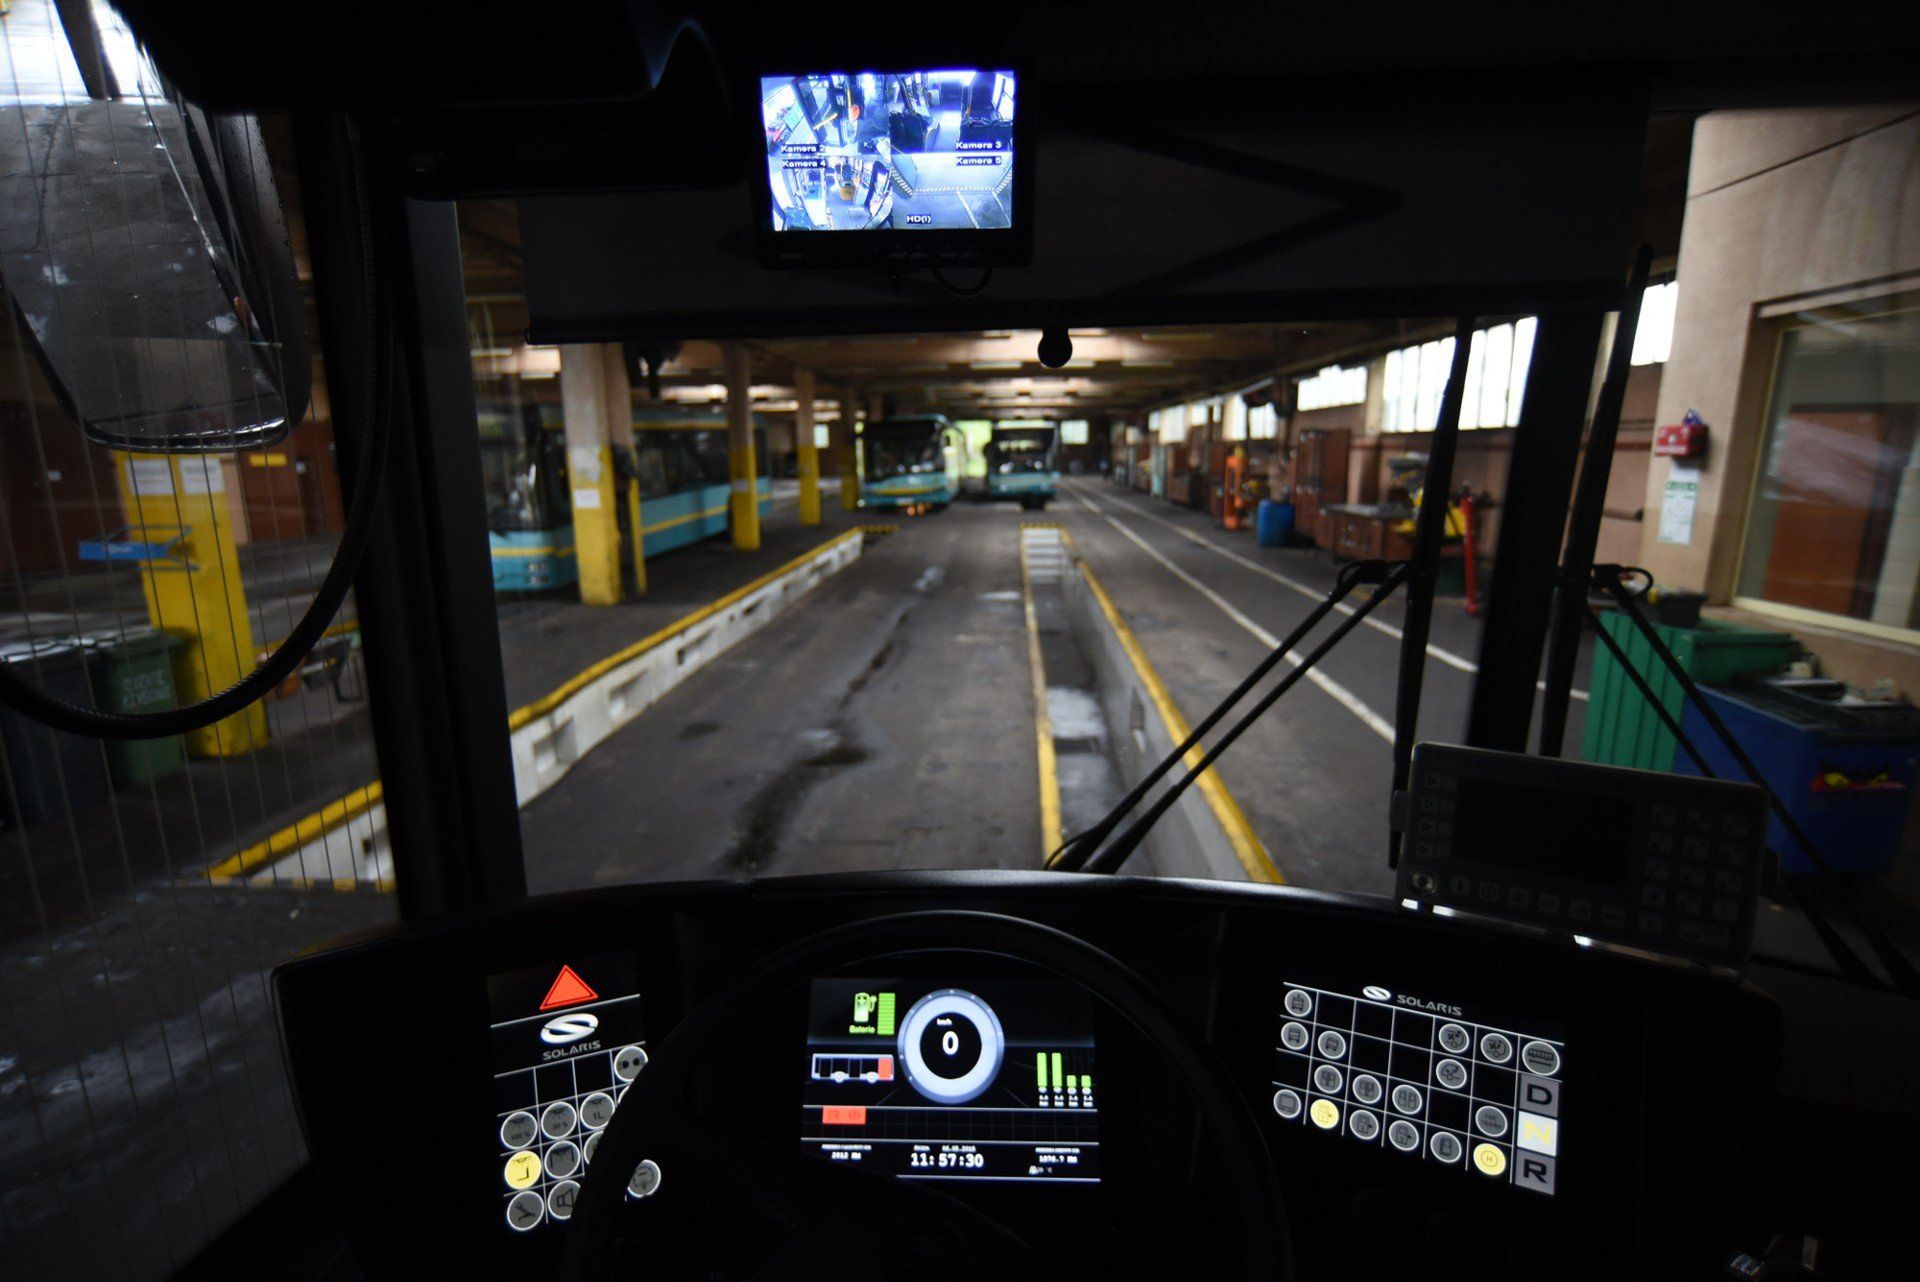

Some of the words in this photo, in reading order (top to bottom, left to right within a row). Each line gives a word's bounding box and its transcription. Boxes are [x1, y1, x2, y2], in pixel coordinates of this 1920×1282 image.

[781, 145, 816, 153] Kamera
[995, 141, 1002, 149] 3
[783, 160, 817, 168] Kamera
[1396, 994, 1462, 1016] SOLARIS
[542, 1040, 601, 1060] SOLARIS
[942, 1031, 959, 1056] 0
[1527, 1083, 1552, 1106] D
[1524, 1121, 1551, 1147] N
[911, 1153, 984, 1168] 11:57:30
[1524, 1159, 1548, 1184] R
